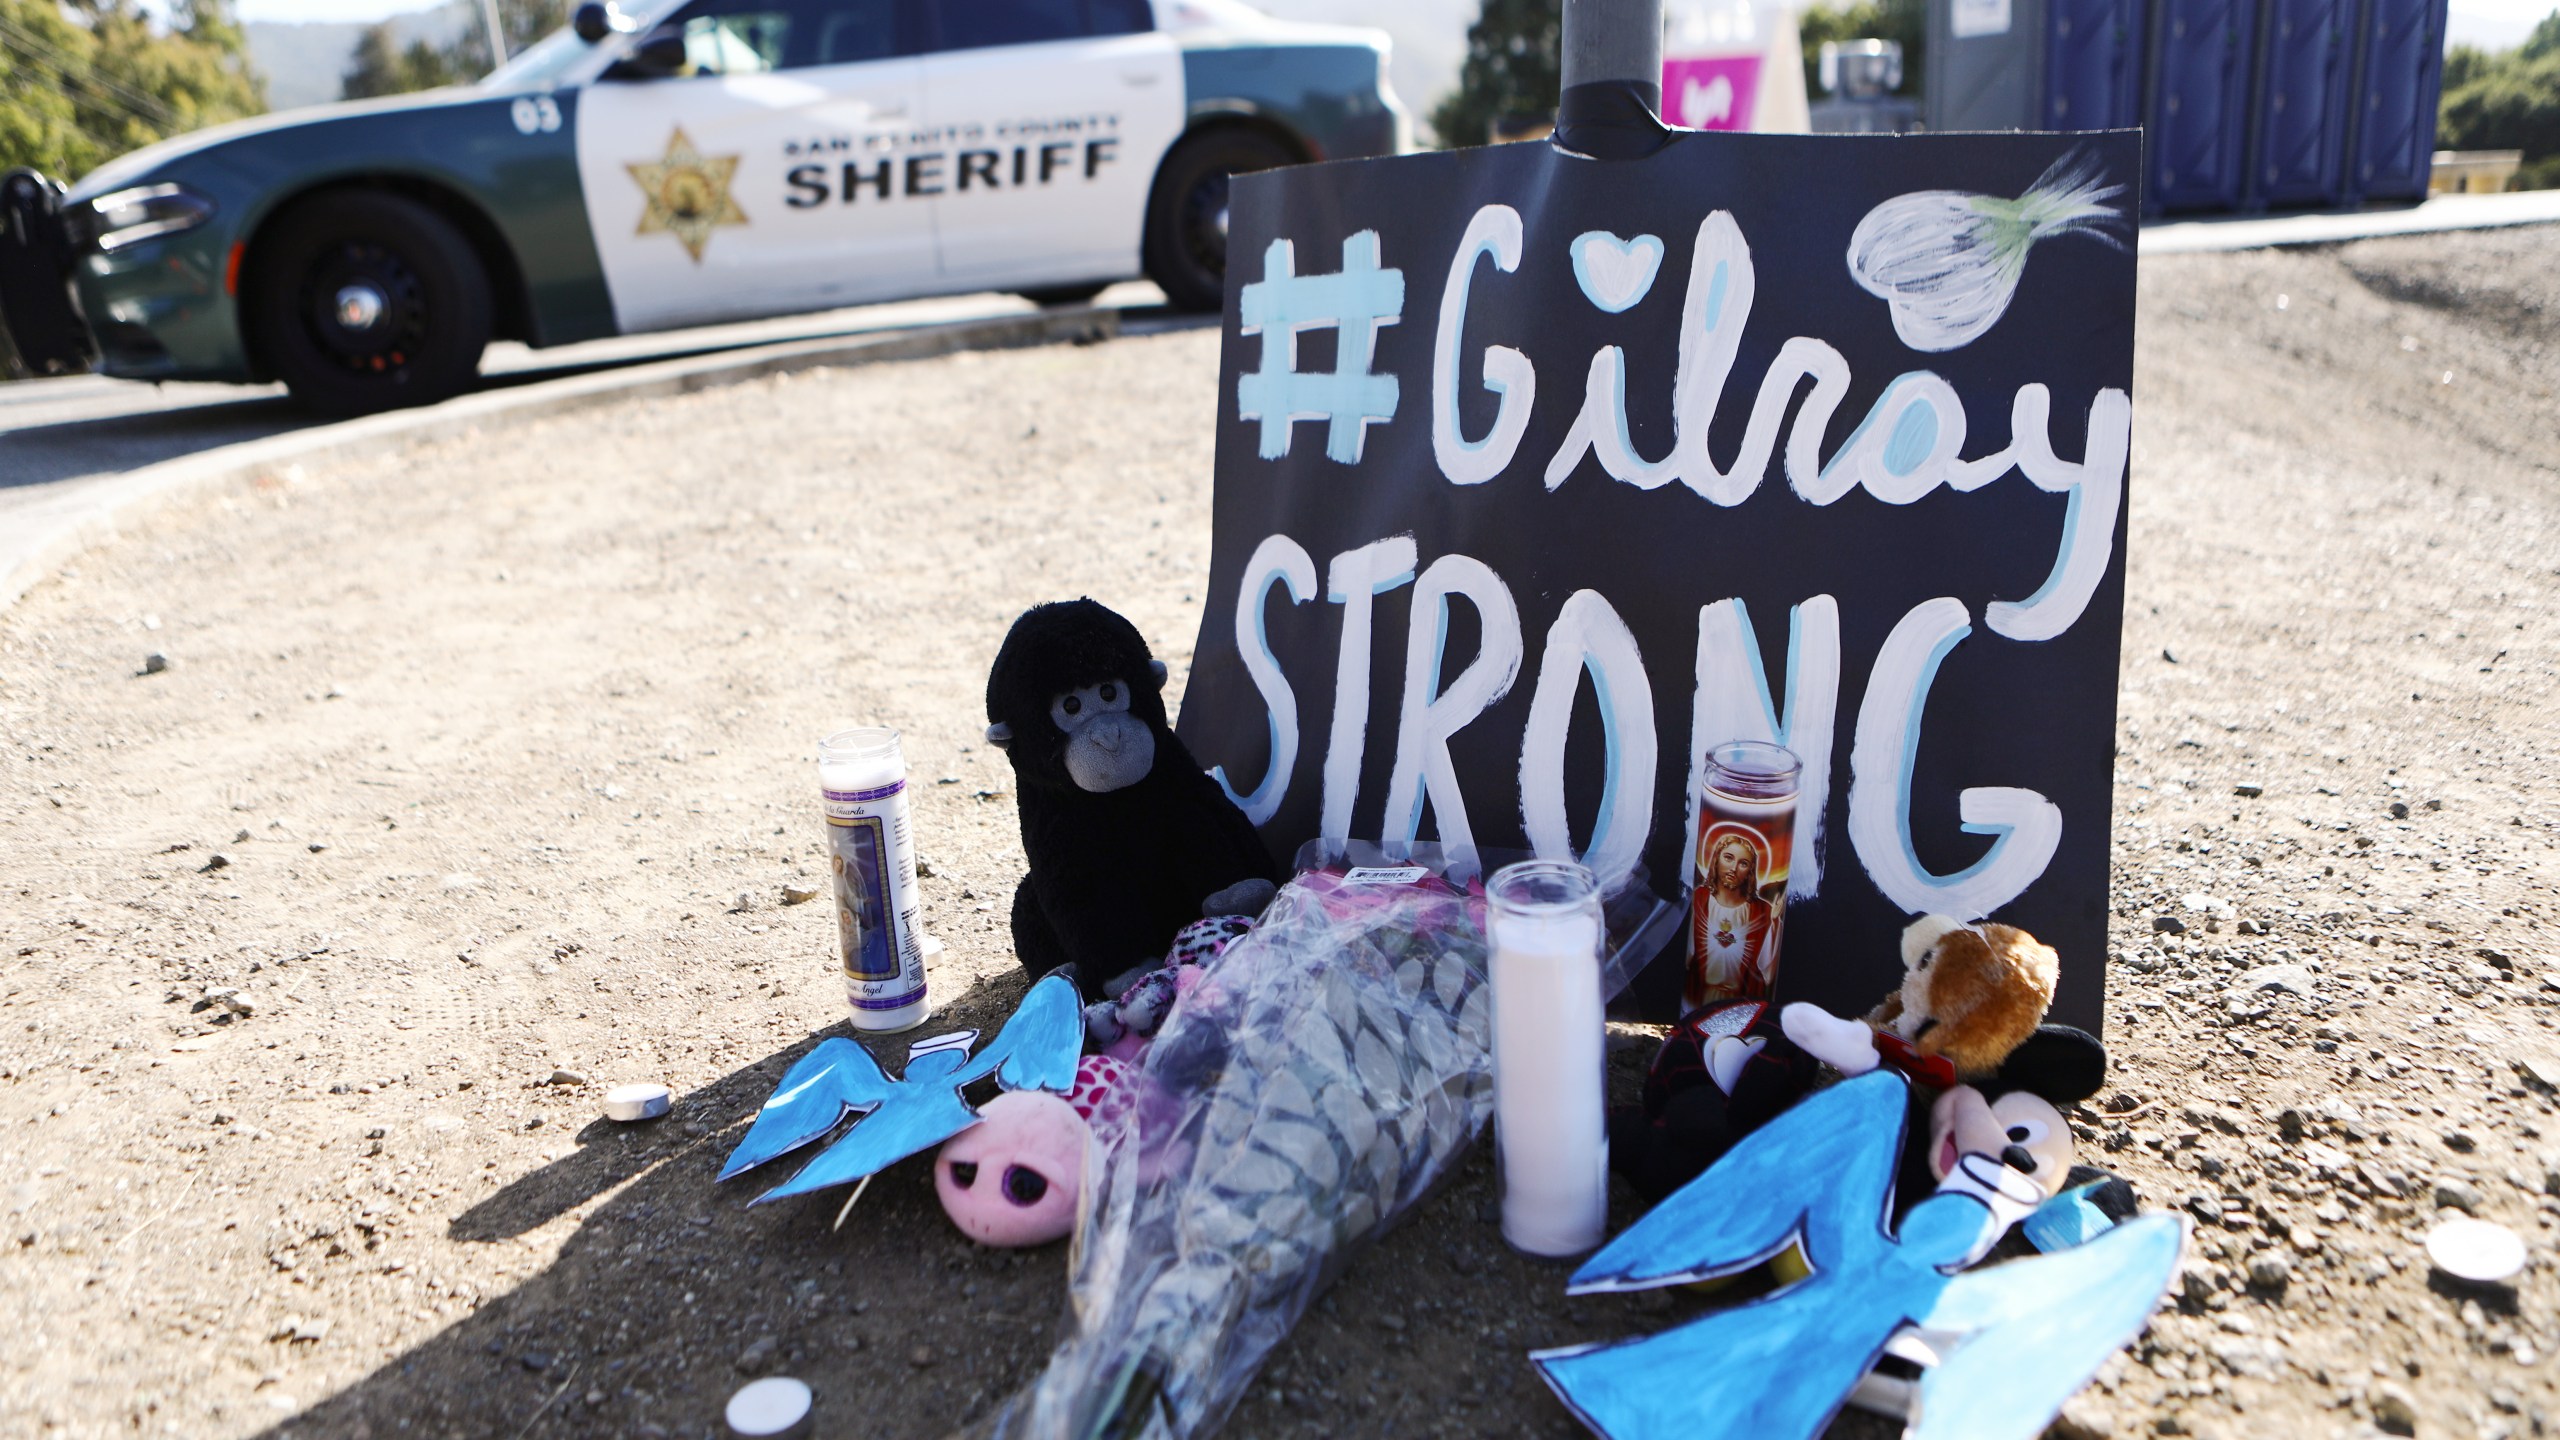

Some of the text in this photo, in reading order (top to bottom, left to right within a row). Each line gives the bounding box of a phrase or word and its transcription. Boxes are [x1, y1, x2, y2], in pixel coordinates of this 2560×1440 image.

[783, 136, 850, 156] SAN
[997, 112, 1120, 138] COUNTY
[785, 136, 1119, 208] SHERIFF
[1238, 203, 2132, 642] #Gilroy
[1205, 531, 2063, 920] STRONG
[835, 805, 865, 816] Guarda
[861, 983, 884, 997] Angel
